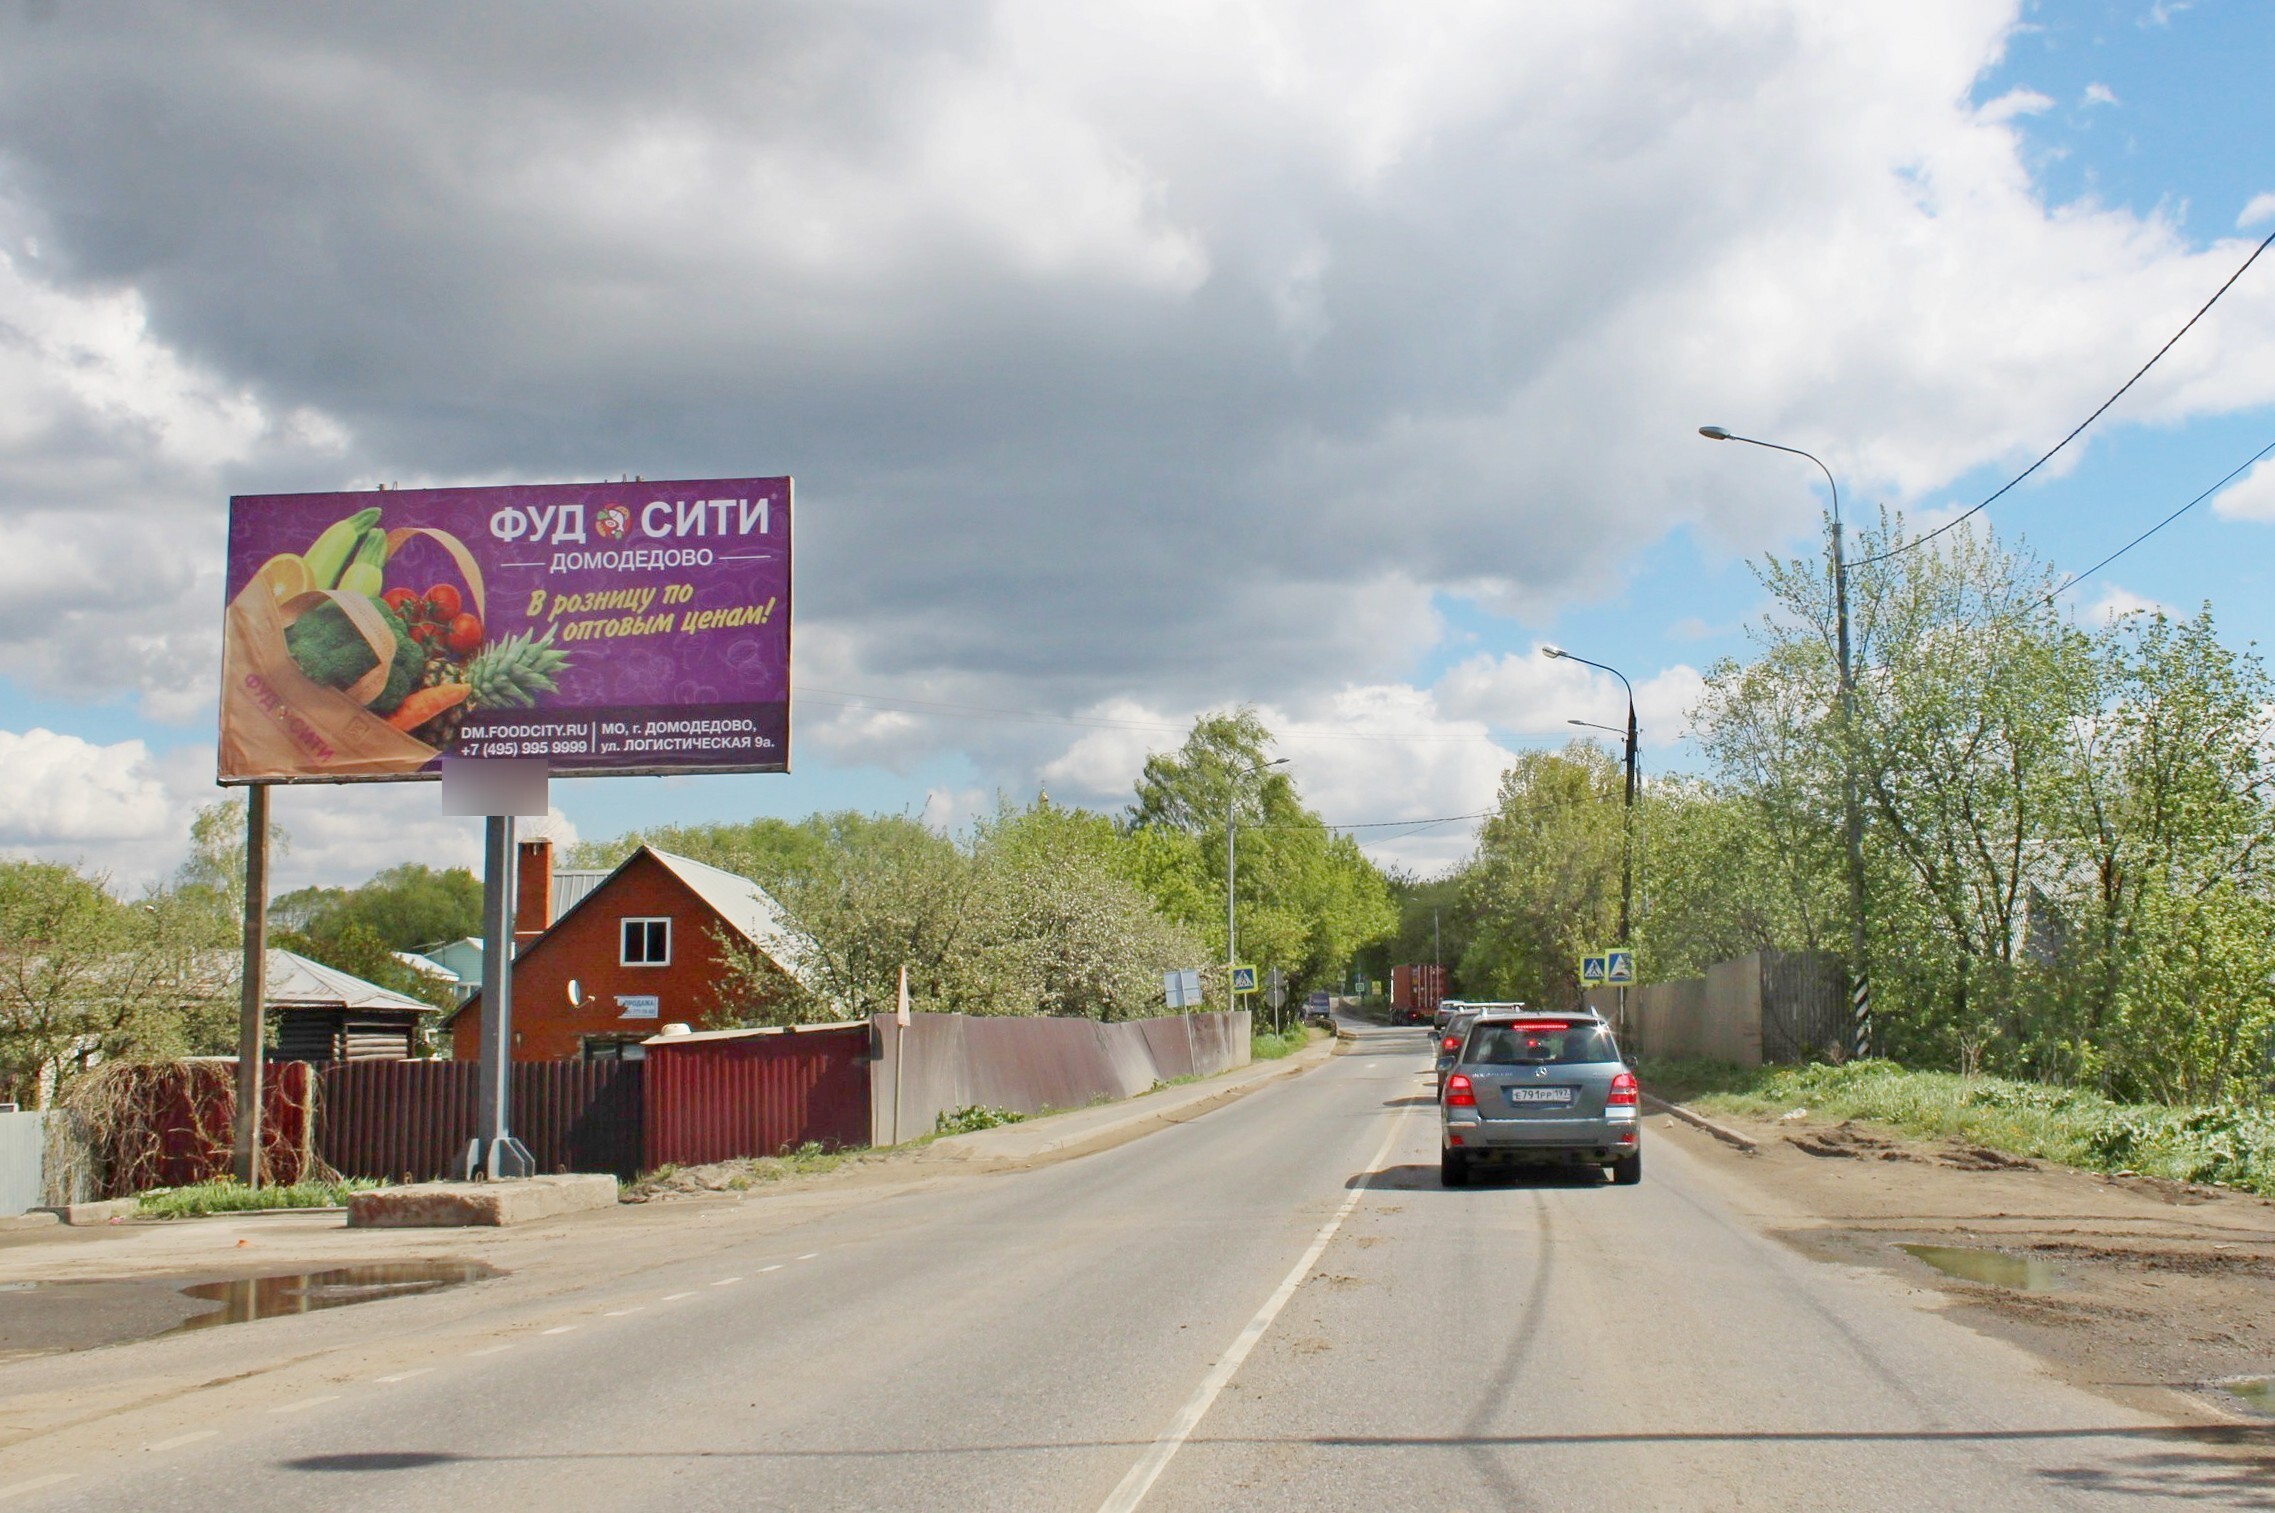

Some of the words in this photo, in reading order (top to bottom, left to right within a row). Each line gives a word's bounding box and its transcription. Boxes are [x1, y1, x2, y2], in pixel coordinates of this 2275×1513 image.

[489, 504, 586, 545] ФУД
[641, 498, 769, 538] СИТИ
[550, 549, 713, 573] ДОМОДЕДОВО
[527, 589, 547, 617] В
[548, 588, 655, 622] розницу
[663, 583, 694, 605] по
[562, 613, 673, 642] оптовым
[681, 597, 776, 635] ценам!
[461, 723, 588, 739] DM.FOODCITY.RU
[601, 722, 629, 736] МО,
[633, 724, 642, 734] г.
[645, 719, 757, 736] ДОМОДЕДОВО,
[461, 743, 479, 756] +7
[483, 742, 518, 758] (495)
[521, 741, 549, 754] 995
[552, 740, 588, 754] 9999
[601, 741, 620, 754] ул.
[623, 736, 752, 752] ЛОГИСТИЧЕСКАЯ
[754, 736, 775, 748] 9а.
